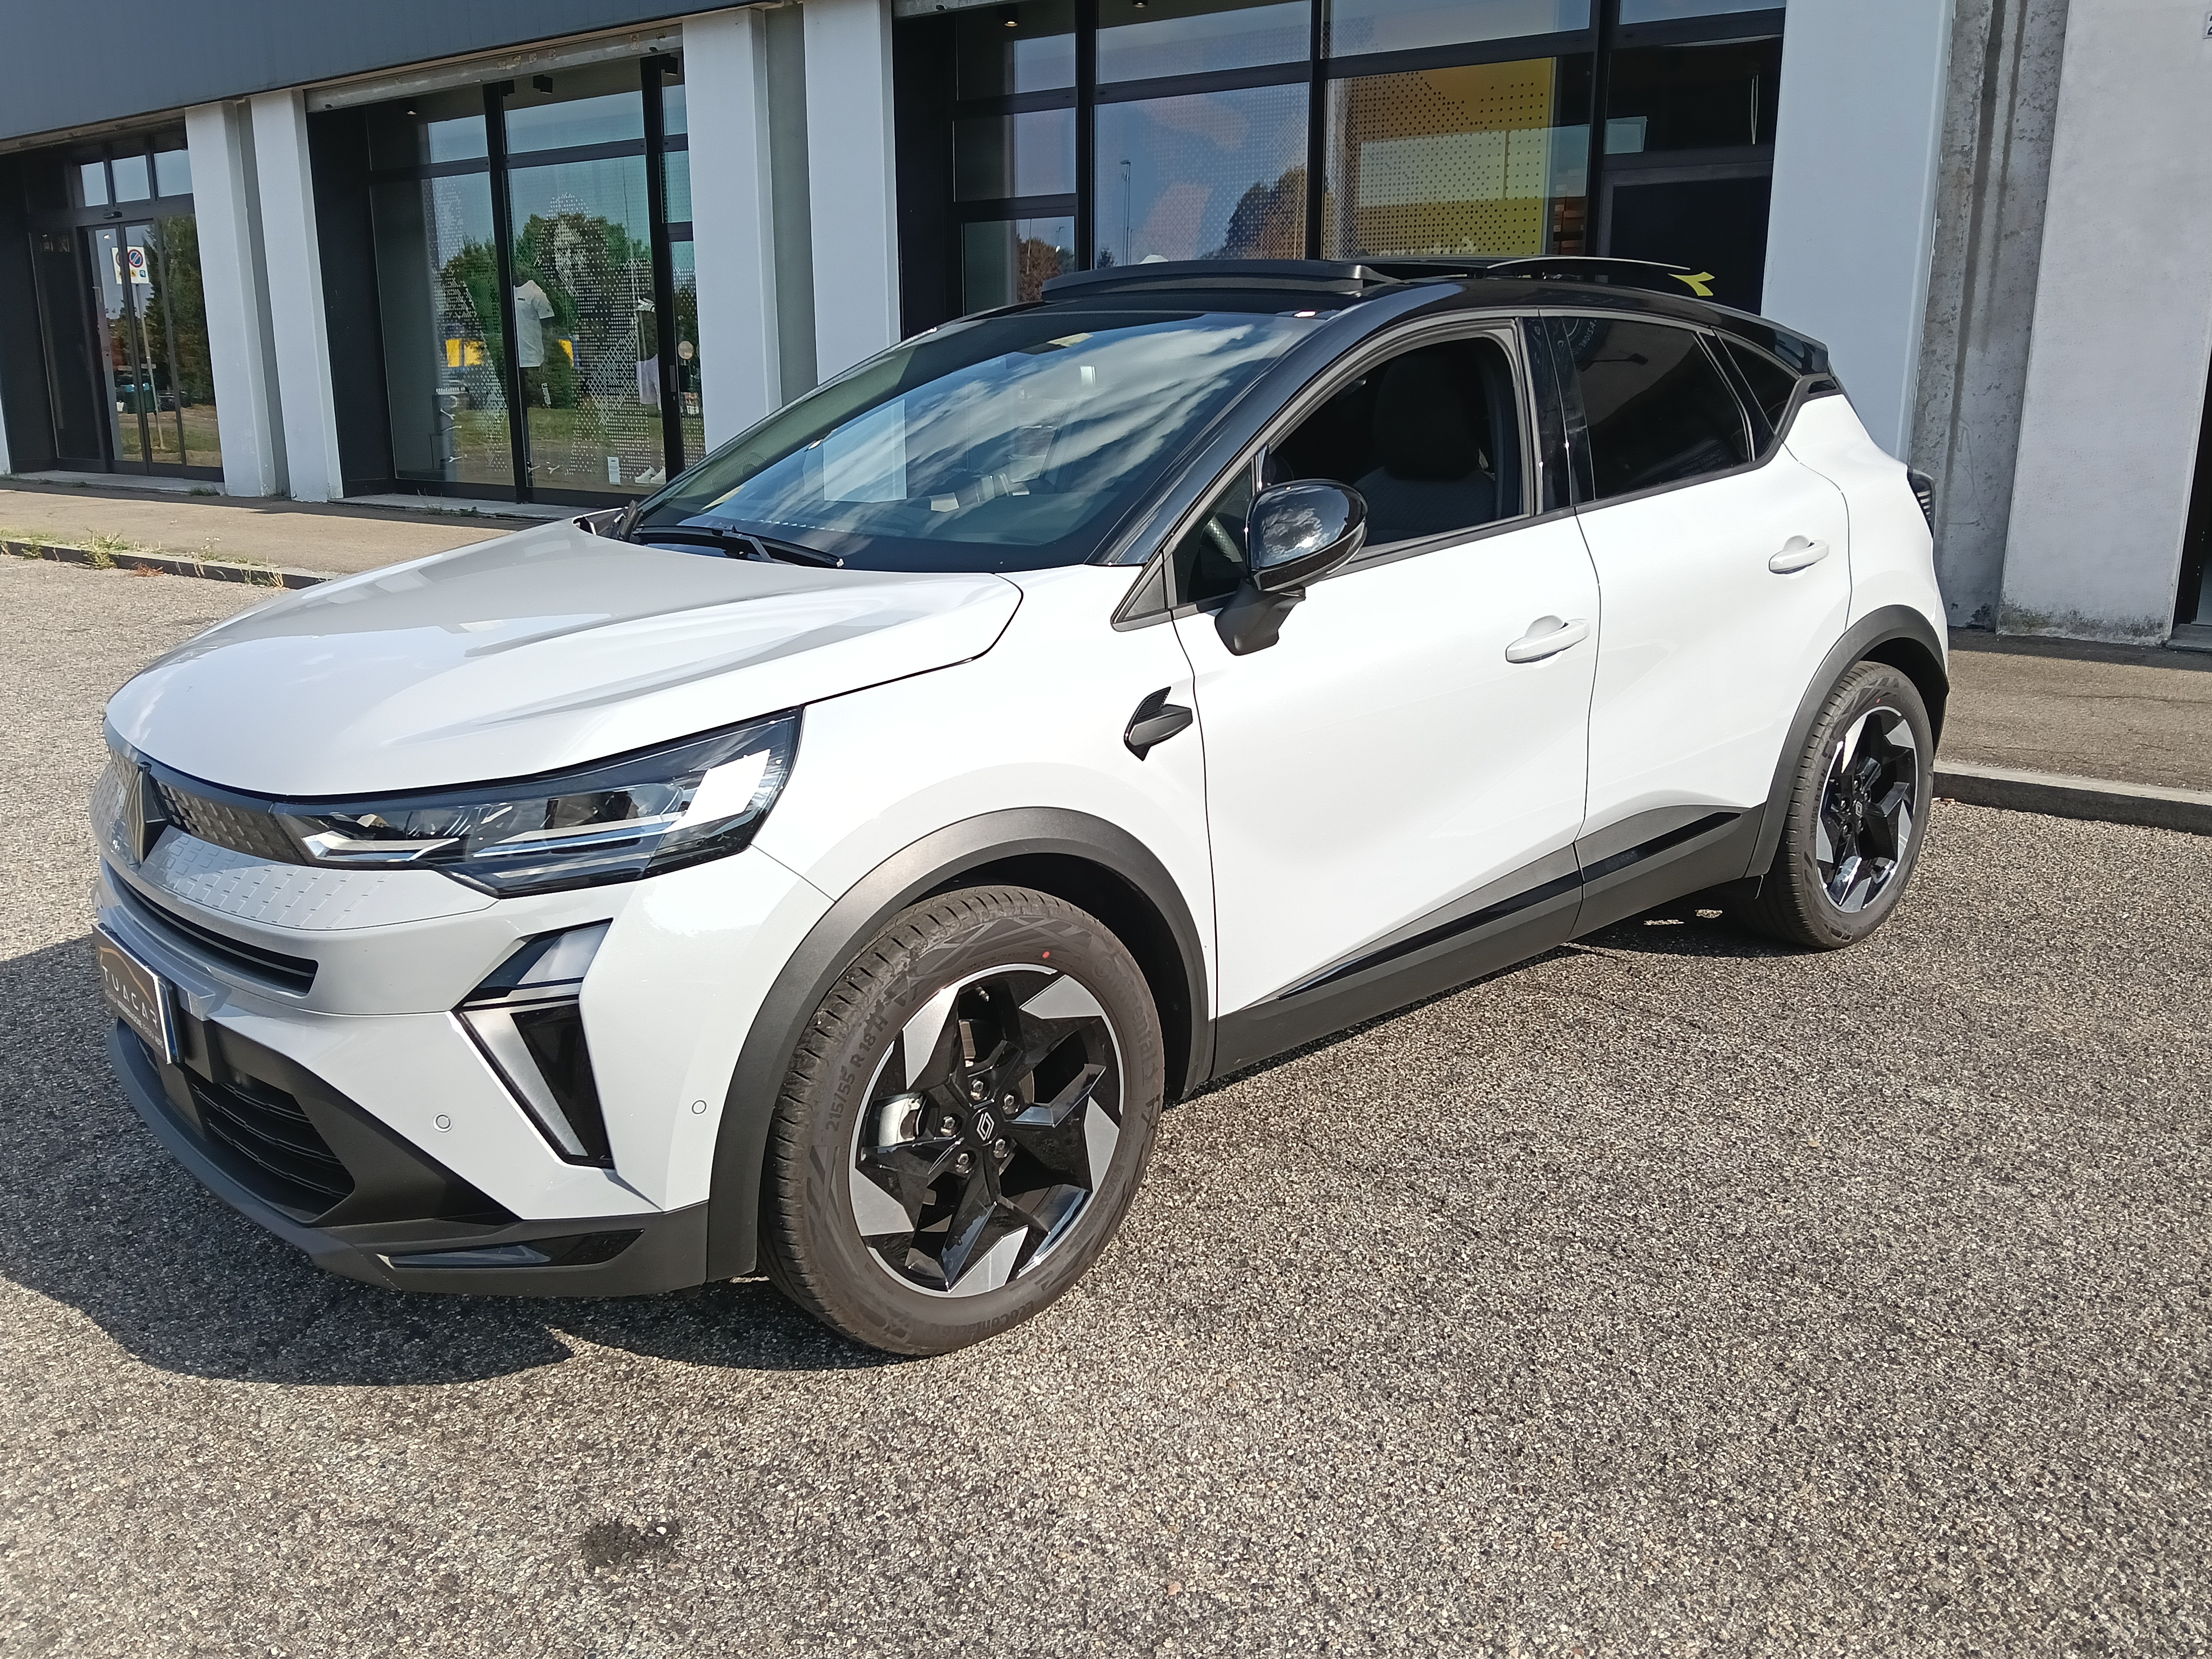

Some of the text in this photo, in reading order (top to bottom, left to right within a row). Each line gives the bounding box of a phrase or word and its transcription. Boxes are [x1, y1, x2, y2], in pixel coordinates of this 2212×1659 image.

[102, 965, 158, 1029] TUACAR
[826, 1015, 889, 1132] 215/55 R 18 H
